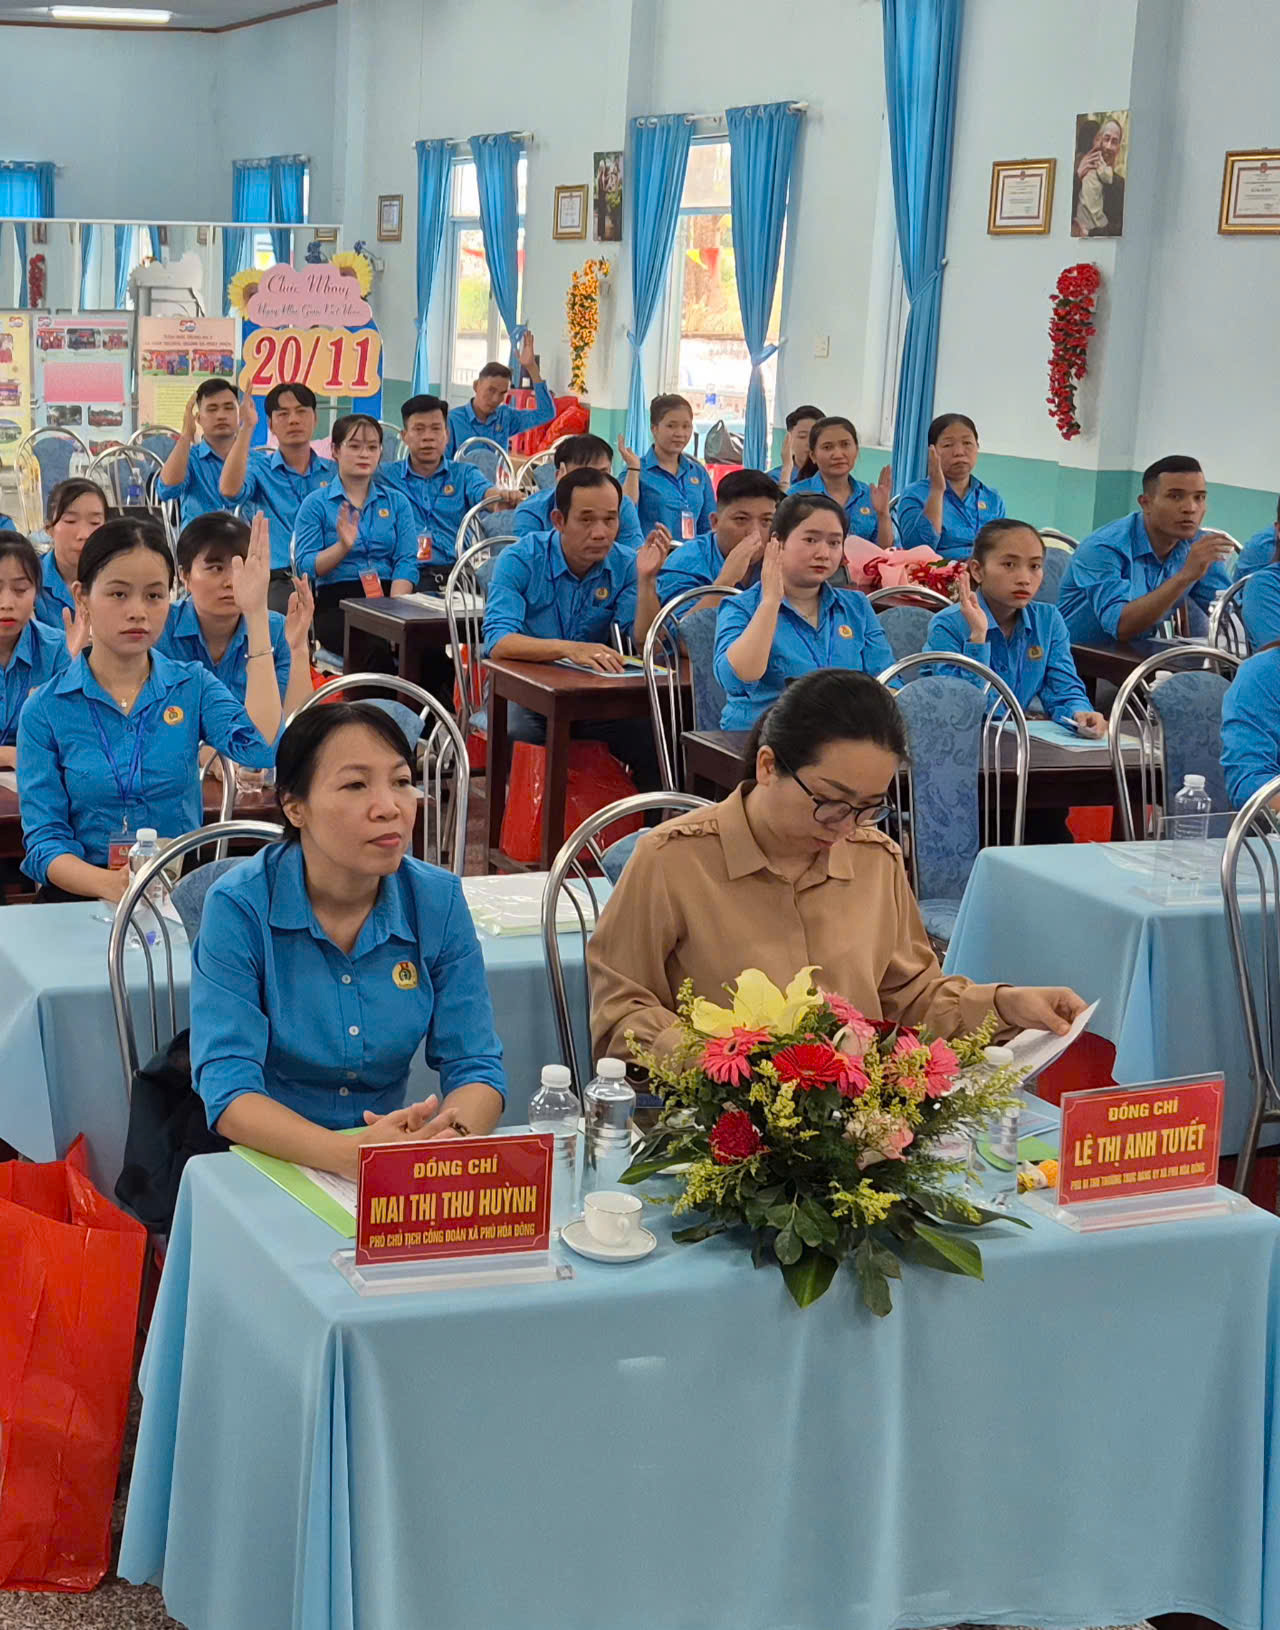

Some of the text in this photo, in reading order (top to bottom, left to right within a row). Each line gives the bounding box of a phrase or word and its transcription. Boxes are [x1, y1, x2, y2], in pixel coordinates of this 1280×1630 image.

[252, 335, 370, 386] 20/11
[1153, 1095, 1179, 1116] CHÍ
[468, 1153, 498, 1175] CHÍ
[1074, 1116, 1207, 1168] LÊ THỊ ANH TUYẾT
[370, 1181, 537, 1226] MAI THỊ THU HUỲNH
